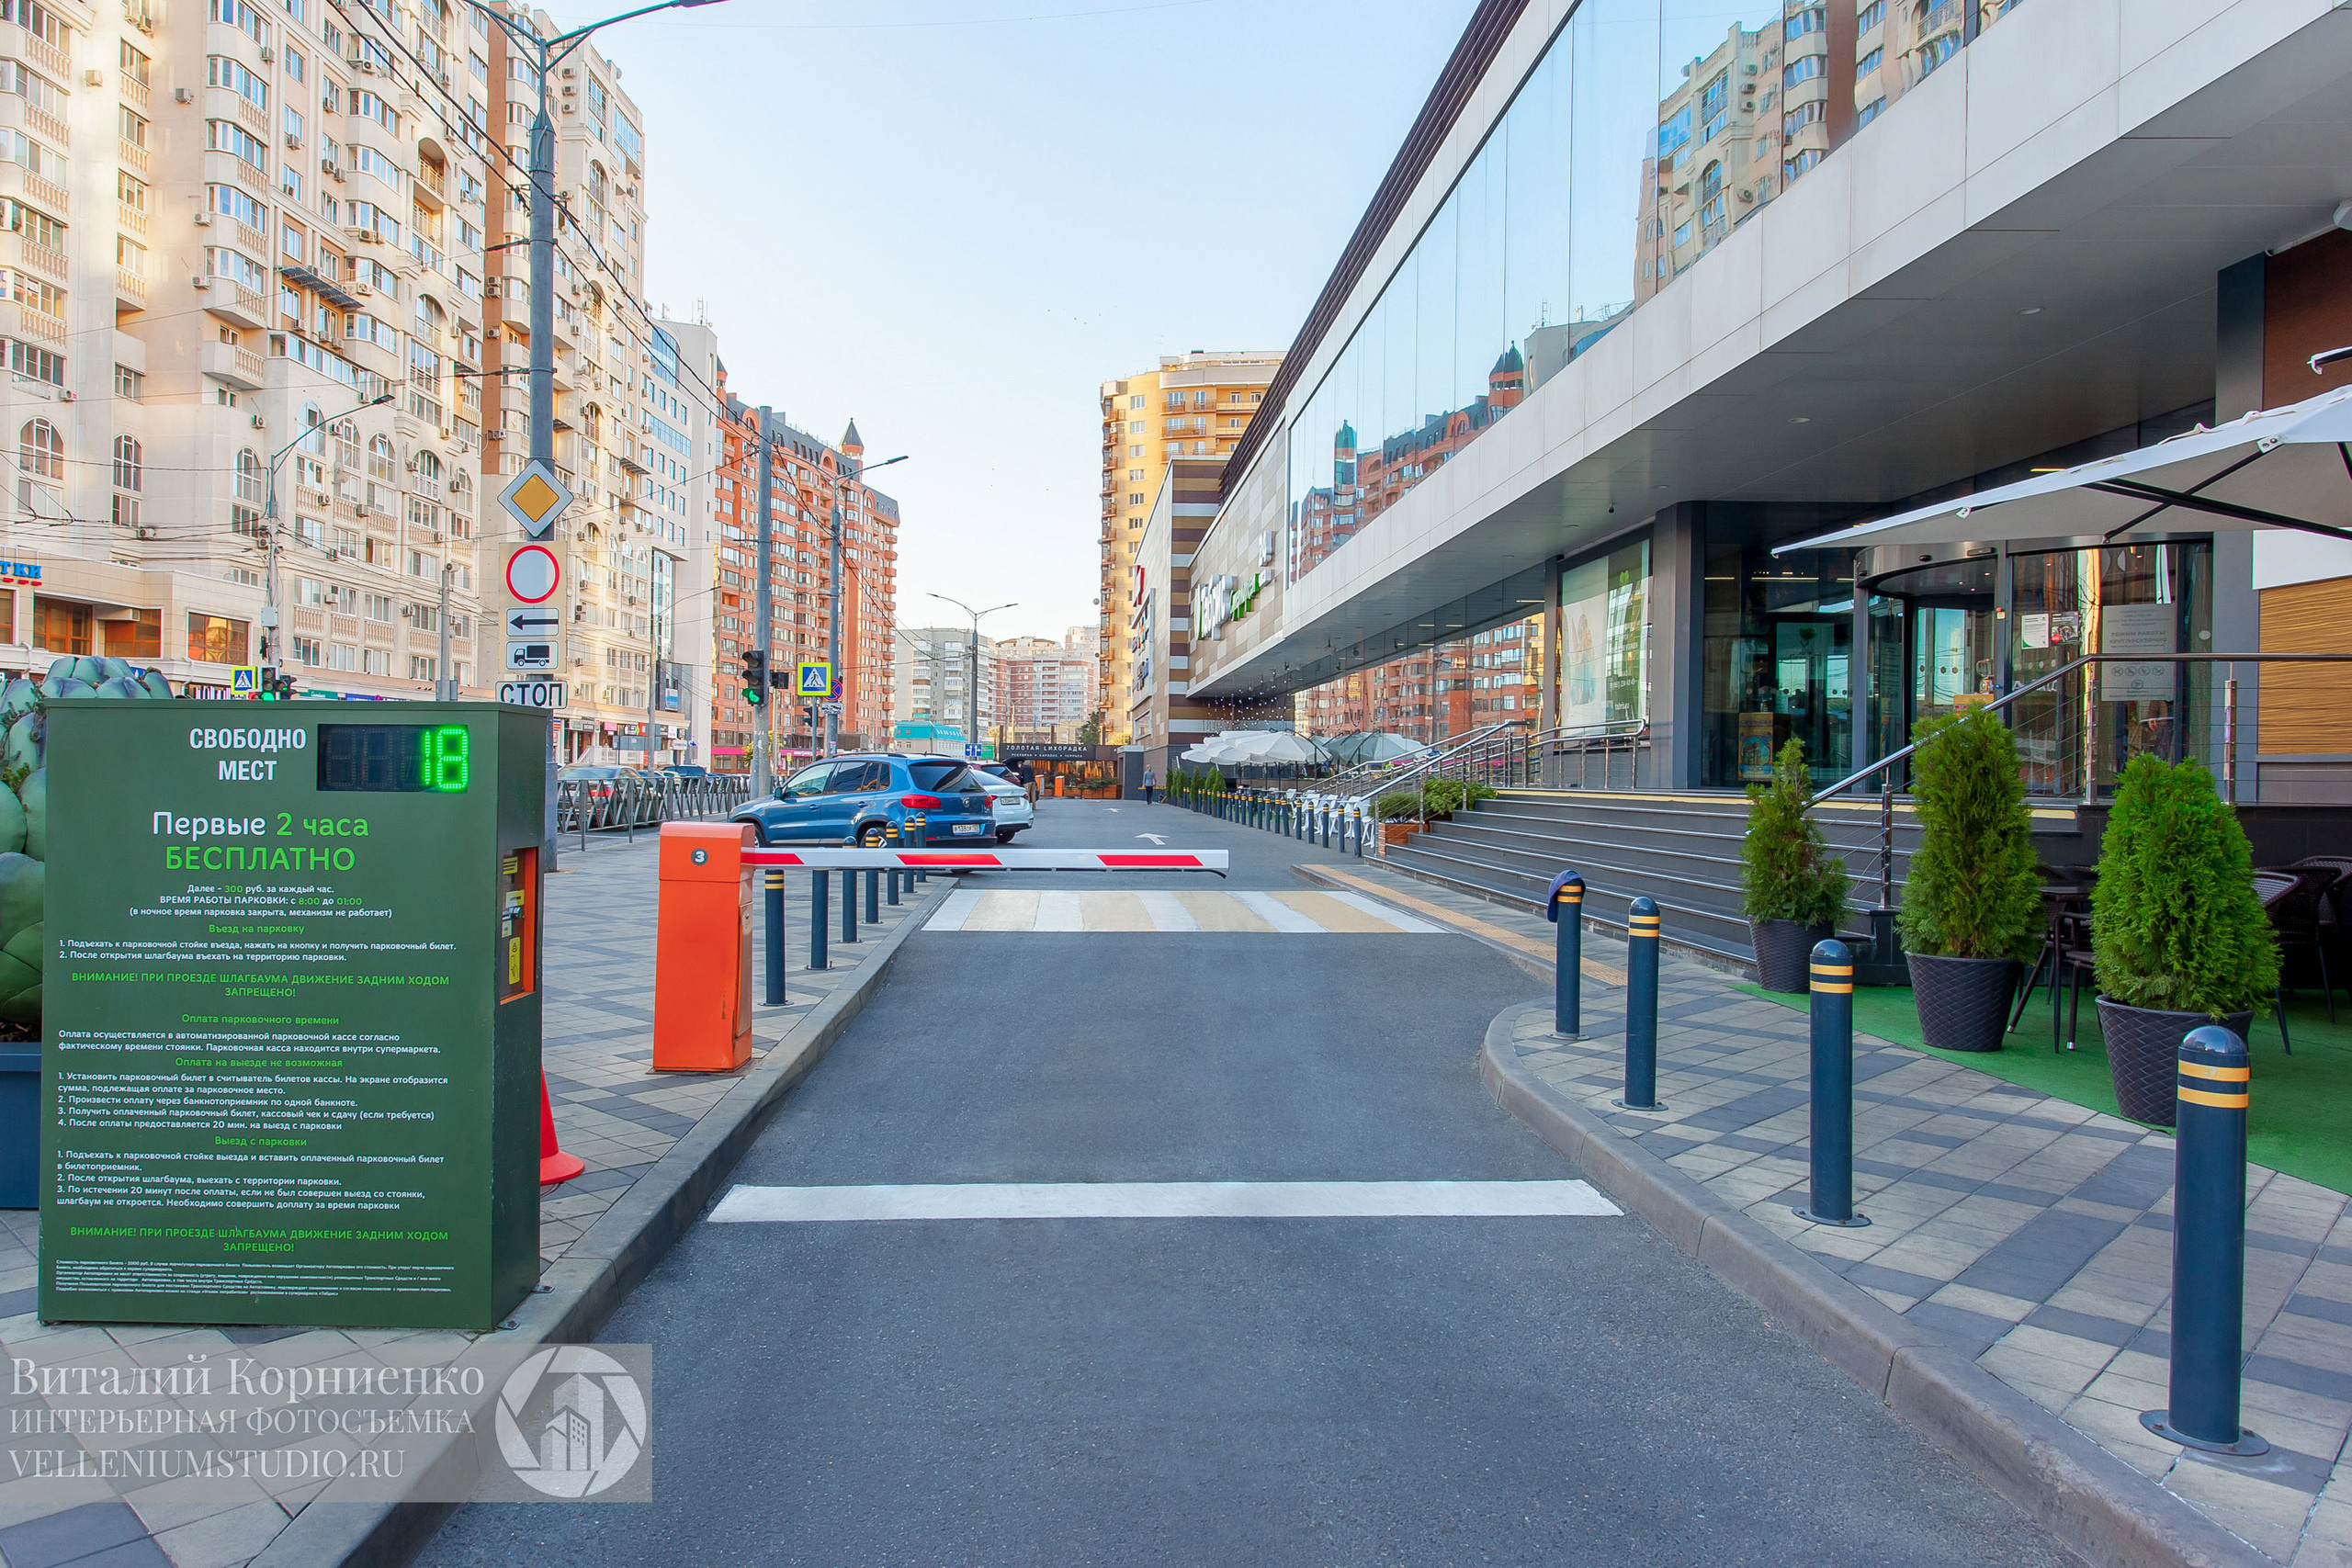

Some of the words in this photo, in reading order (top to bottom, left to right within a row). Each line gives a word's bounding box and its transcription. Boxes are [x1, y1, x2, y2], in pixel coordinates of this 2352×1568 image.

[500, 682, 562, 707] СТОП
[190, 728, 306, 751] СВОБОДНО
[424, 728, 469, 791] 18
[220, 761, 277, 781] МЕСТ
[154, 812, 266, 840] Первые
[277, 812, 292, 836] 2
[303, 818, 368, 836] часа
[167, 847, 355, 871] БЕСПЛАТНО
[695, 851, 705, 863] 3
[187, 885, 215, 894] Далее
[246, 885, 265, 895] руб.
[279, 886, 315, 894] каждый
[161, 896, 191, 904] ВРЕМЯ
[194, 896, 232, 904] РАБОТЫ
[337, 897, 362, 906] 01:00
[130, 908, 139, 917] (в
[205, 909, 245, 918] парковка
[248, 909, 287, 918] закрыта,
[349, 908, 392, 919] работает)
[209, 924, 239, 934] Въезд
[257, 926, 305, 935] парковку
[68, 940, 114, 948] Подъехать
[123, 941, 177, 950] парковочной
[330, 943, 369, 952] получить
[371, 942, 427, 952] парковочный
[71, 951, 98, 959] После
[145, 952, 194, 962] шлагбаума
[246, 954, 300, 963] территорию
[303, 954, 346, 963] парковки.
[73, 973, 138, 982] ВНИМАНИЕ!
[141, 973, 164, 981] ПРИ
[167, 974, 216, 984] ПРОЕЗДЕ
[220, 974, 288, 983] ШЛАГБАУМА
[291, 976, 354, 986] ДВИЖЕНИЕ
[357, 976, 405, 987] ЗАДНИМ
[409, 976, 449, 987] ХОДОМ
[225, 987, 296, 998] ЗАПРЕЩЕНО!
[182, 1014, 219, 1022] Оплата
[221, 1017, 292, 1026] парковочного
[296, 1018, 339, 1026] времени
[59, 1030, 91, 1038] Оплата
[175, 1032, 270, 1042] автоматизированной
[272, 1032, 330, 1043] парковочной
[59, 1042, 123, 1052] фактическому
[125, 1043, 164, 1052] времени
[207, 1043, 265, 1053] Парковочная
[343, 1046, 373, 1055] внутри
[376, 1046, 441, 1055] супермаркета.
[175, 1057, 212, 1066] Оплата
[231, 1060, 267, 1068] выезде
[59, 1095, 66, 1103] 2.
[69, 1096, 121, 1105] Произвести
[123, 1098, 154, 1106] оплату
[184, 1097, 268, 1107] банкнотоприемник
[285, 1099, 312, 1107] одной
[314, 1099, 358, 1107] банкноте.
[69, 1107, 111, 1117] Получить
[114, 1108, 167, 1116] оплаченный
[169, 1109, 229, 1119] парковочный
[231, 1109, 259, 1118] билет,
[261, 1110, 304, 1118] кассовый
[332, 1111, 357, 1120] сдачу
[360, 1111, 384, 1121] (если
[387, 1111, 435, 1121] требуется)
[215, 1136, 247, 1146] Выезд
[259, 1139, 307, 1148] парковки
[65, 1162, 142, 1172] билетоприемник.
[57, 1173, 65, 1181] 2.
[98, 1176, 141, 1184] открытия
[142, 1174, 195, 1185] шлагбаума,
[243, 1178, 295, 1187] территории
[298, 1179, 342, 1187] парковки.
[71, 1227, 136, 1236] ВНИМАНИЕ!
[140, 1228, 162, 1236] ПРИ
[165, 1228, 215, 1239] ПРОЕЗДЕ
[220, 1228, 287, 1238] ШЛАГБАУМА
[290, 1230, 353, 1240] ДВИЖЕНИЕ
[356, 1231, 403, 1241] ЗАДНИМ
[407, 1231, 448, 1242] ХОДОМ
[223, 1242, 294, 1253] ЗАПРЕЩЕНО!
